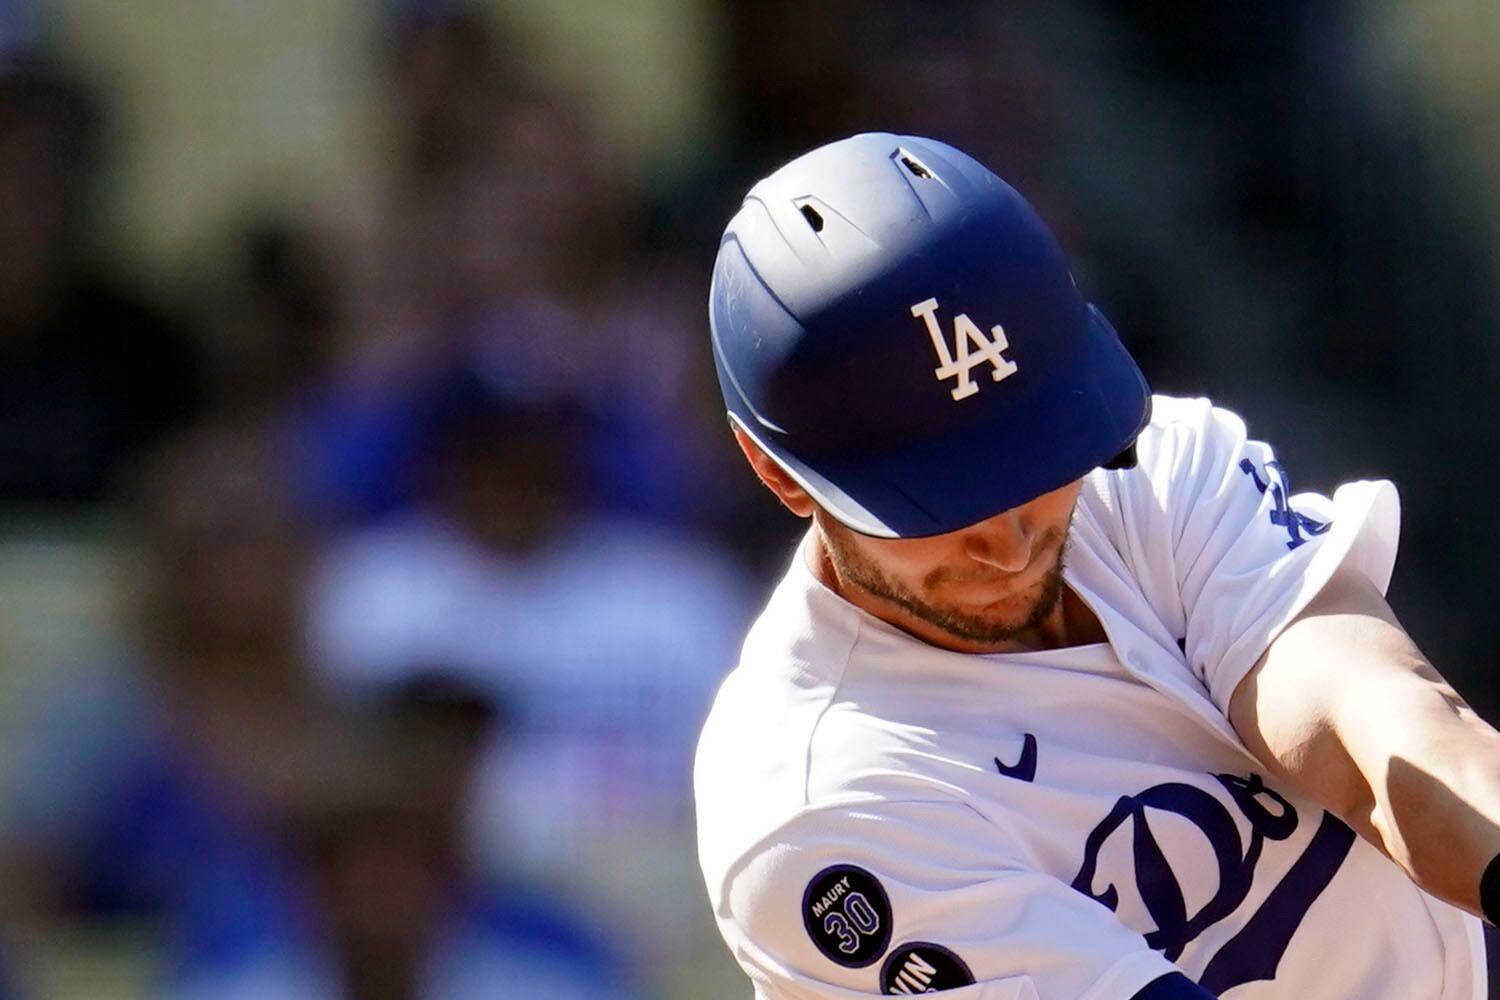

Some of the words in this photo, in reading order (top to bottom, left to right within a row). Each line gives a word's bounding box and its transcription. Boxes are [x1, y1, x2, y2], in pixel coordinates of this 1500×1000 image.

[910, 297, 1018, 401] LA
[811, 876, 851, 918] MAURY
[823, 891, 880, 954] 30
